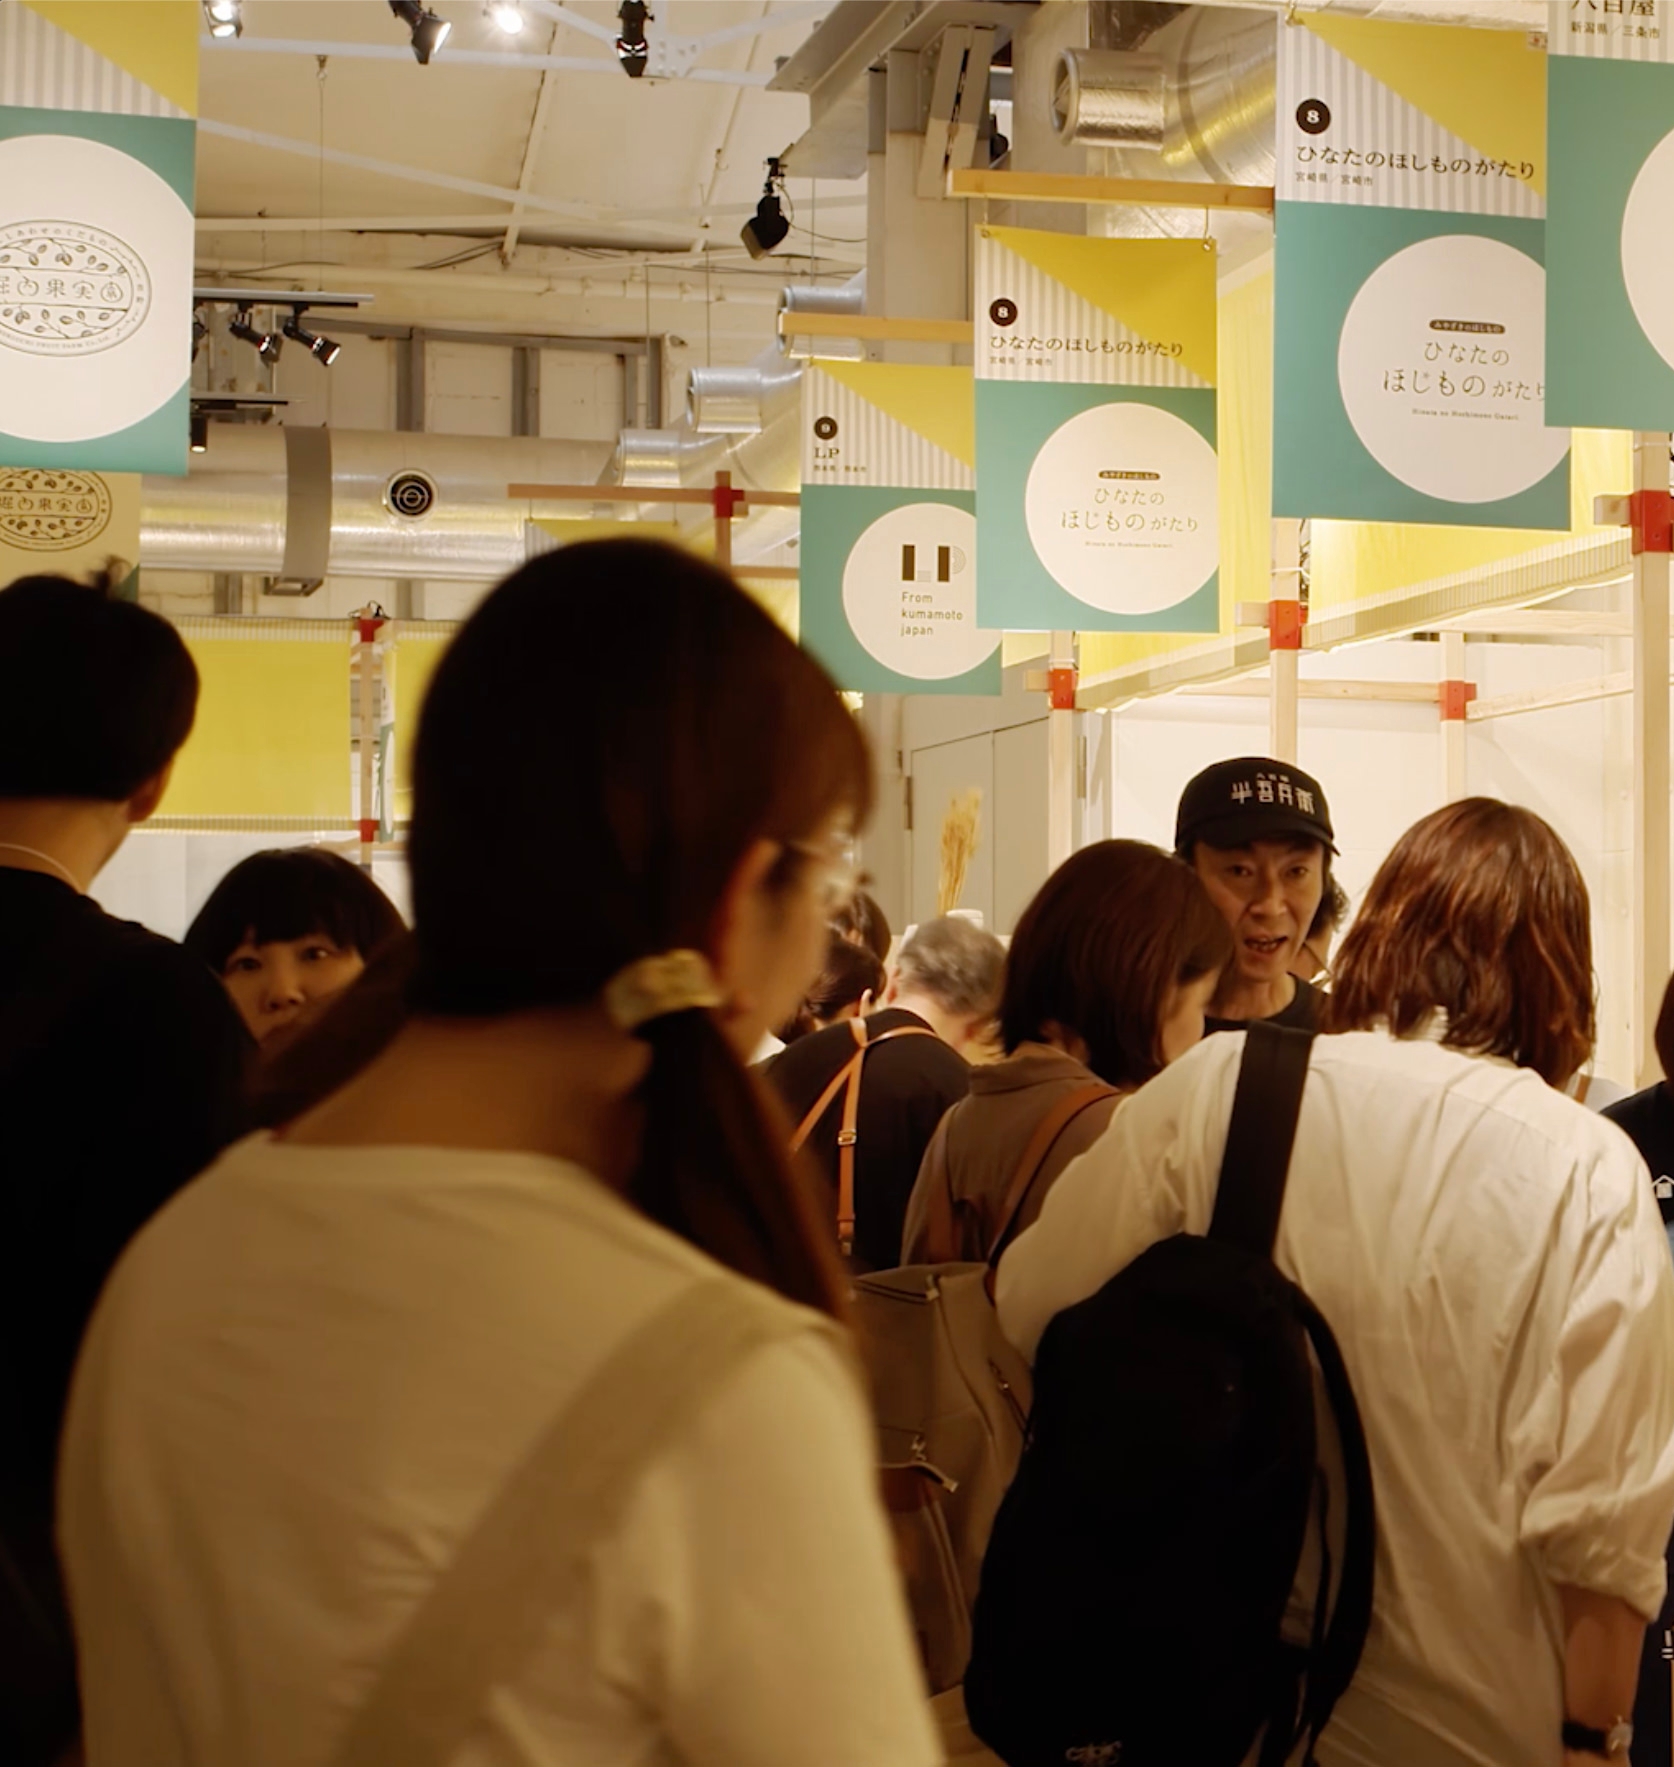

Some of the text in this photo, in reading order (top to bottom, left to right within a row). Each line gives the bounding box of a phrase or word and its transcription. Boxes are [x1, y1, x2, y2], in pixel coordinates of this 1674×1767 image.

[1306, 110, 1320, 124] 8
[1297, 146, 1534, 180] ひなたのほしものがたり
[998, 307, 1008, 318] 8
[990, 336, 1183, 357] ひなたのほしものがたり
[1424, 341, 1510, 366] ひなたの
[815, 447, 840, 459] LP
[1094, 487, 1165, 505] ひなたの
[902, 591, 933, 604] From
[901, 608, 963, 620] kumamoto
[900, 624, 933, 637] japan
